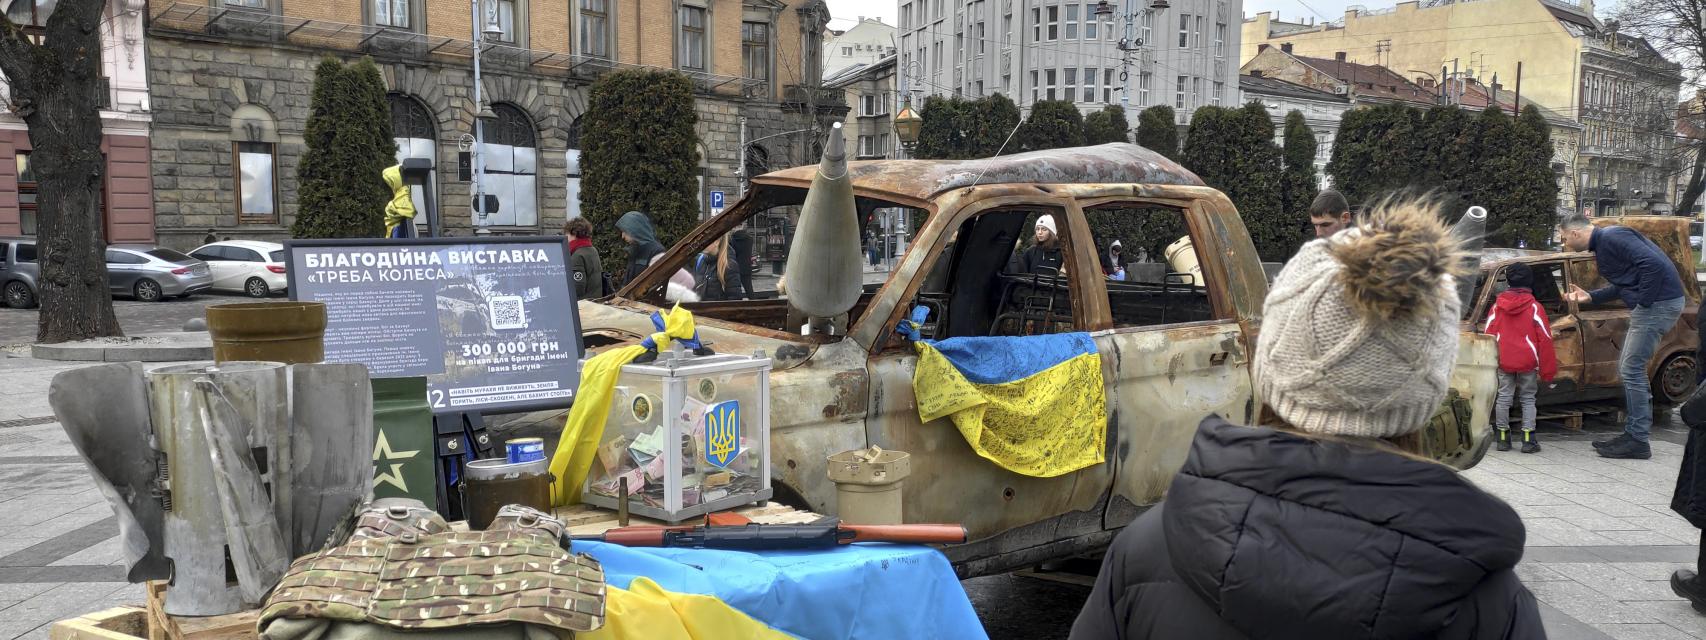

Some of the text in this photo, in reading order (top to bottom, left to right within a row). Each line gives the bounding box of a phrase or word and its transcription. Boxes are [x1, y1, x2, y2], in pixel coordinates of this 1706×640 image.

[305, 248, 549, 268] БЛАГОДІЙНА ВИСТАВКА
[307, 267, 455, 284] «ТРЕБА КОЛЕСА»
[461, 341, 559, 357] 300 000 грн
[468, 357, 491, 365] пікап
[511, 354, 545, 364] бригади
[487, 362, 541, 373] Івана Богуна
